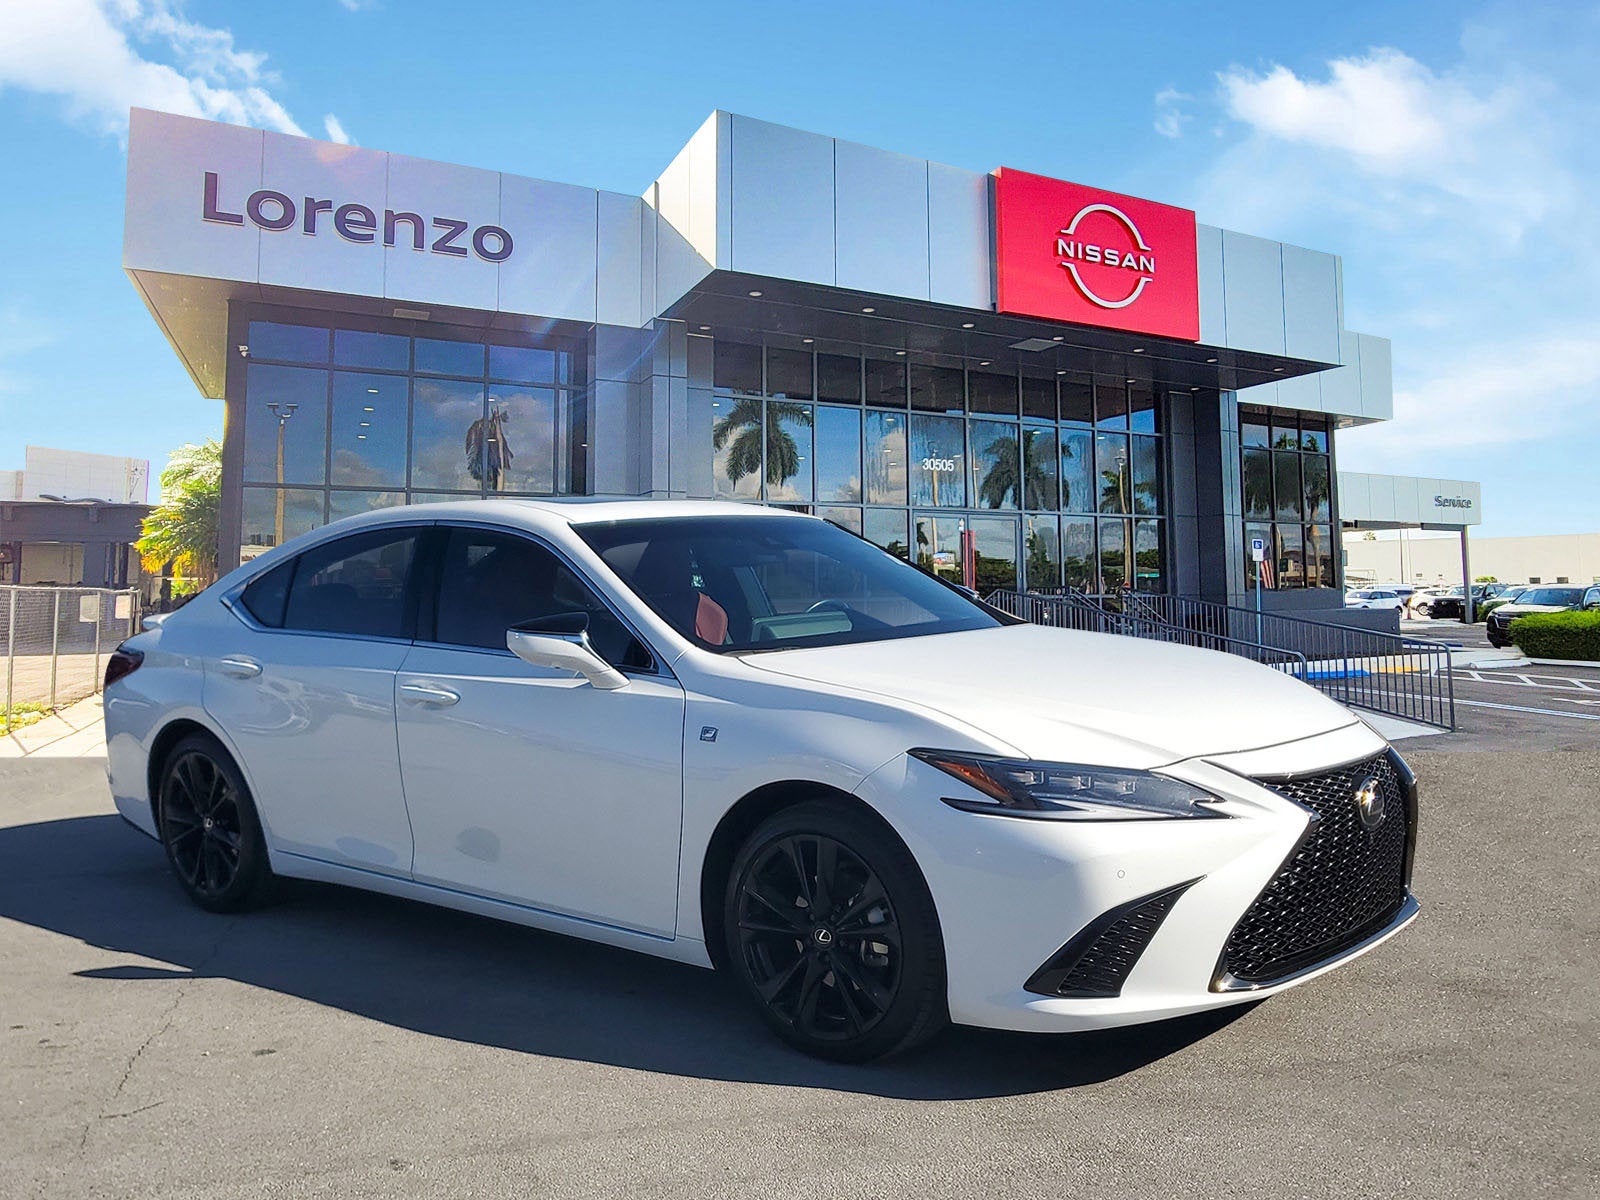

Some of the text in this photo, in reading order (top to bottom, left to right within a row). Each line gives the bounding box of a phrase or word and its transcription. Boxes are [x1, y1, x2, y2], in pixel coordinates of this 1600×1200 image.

[203, 171, 514, 262] Lorenzo
[1057, 238, 1155, 273] NISSAN
[922, 458, 954, 471] 30505
[1434, 495, 1472, 508] Service
